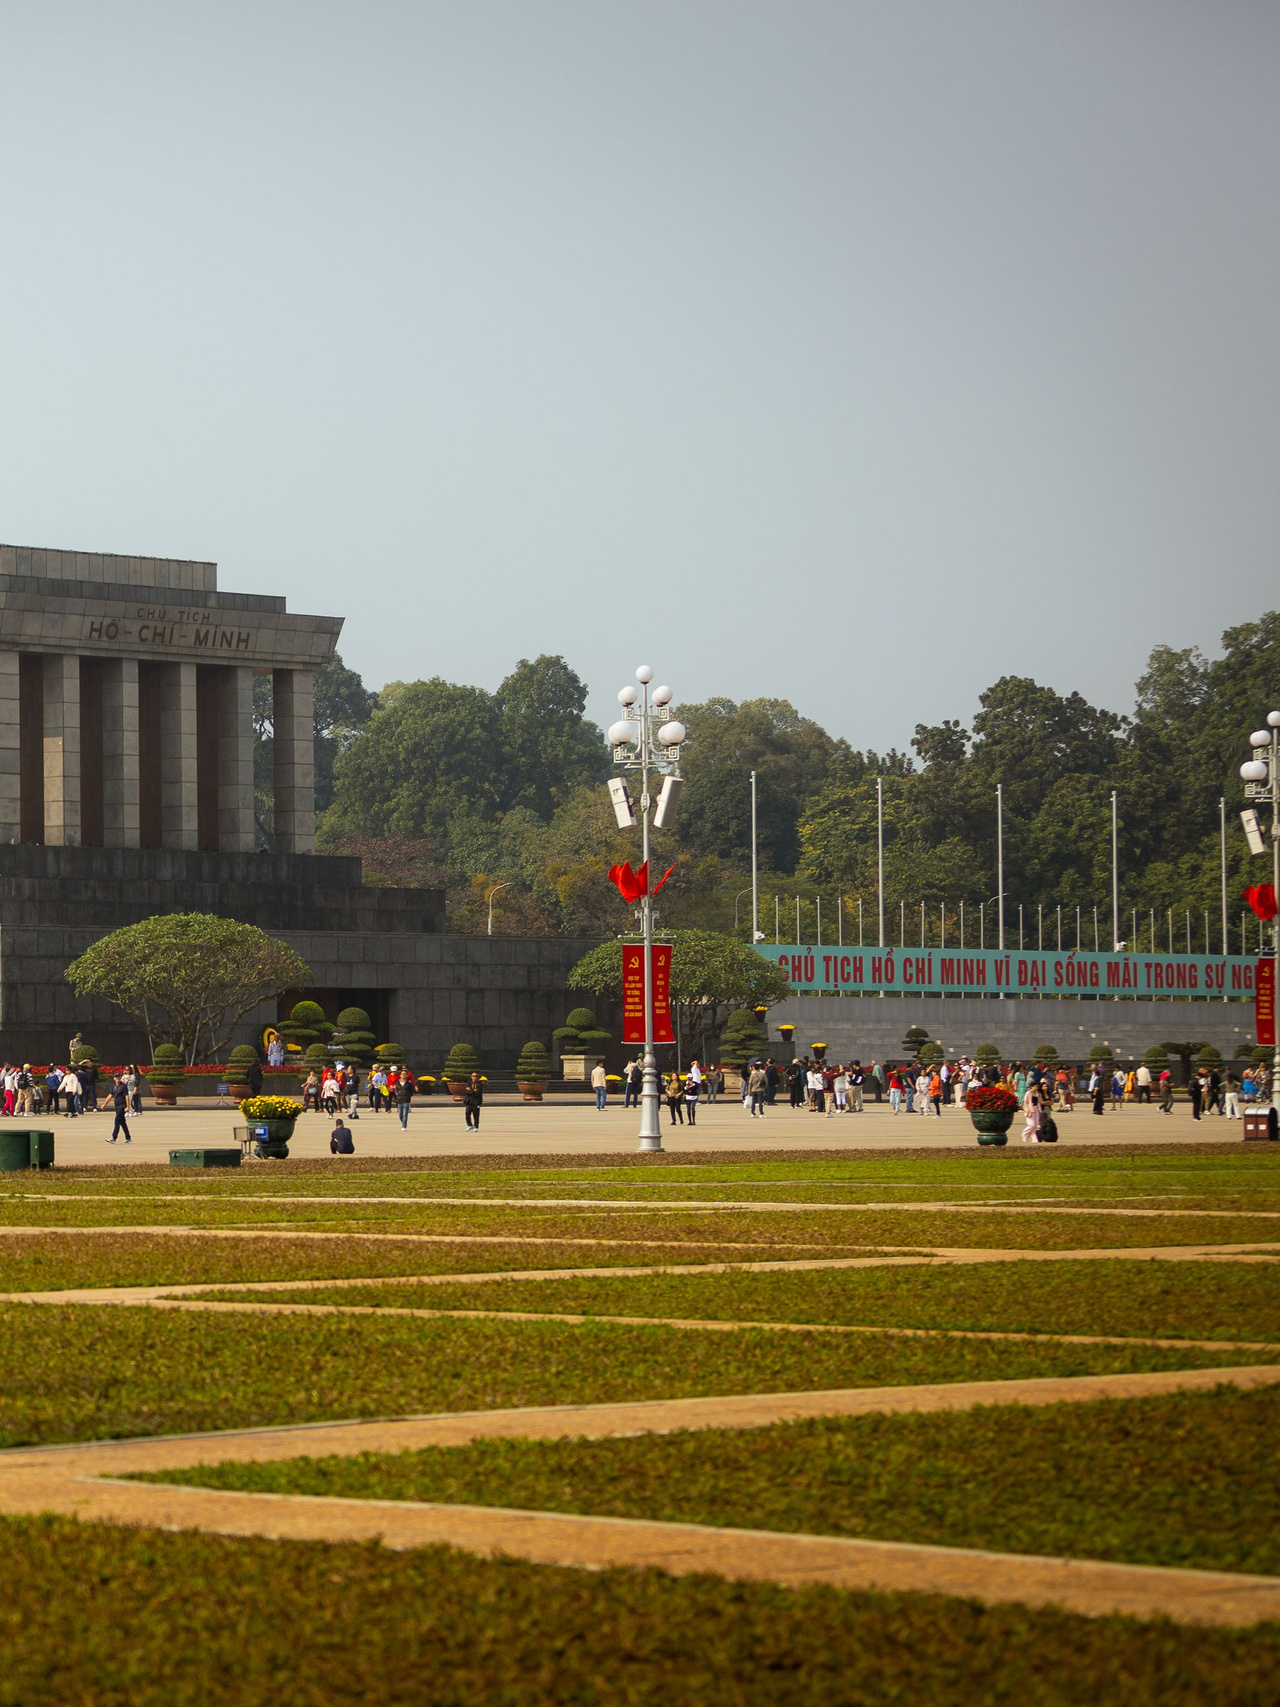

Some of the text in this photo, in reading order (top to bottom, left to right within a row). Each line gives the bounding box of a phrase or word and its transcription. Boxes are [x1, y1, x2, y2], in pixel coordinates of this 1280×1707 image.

[137, 604, 167, 620] CHỦ
[89, 618, 122, 641] HỒ
[138, 621, 177, 645] CHÍ
[193, 625, 251, 650] MINH
[778, 946, 815, 983] CHỦ
[823, 955, 864, 988] TỊCH
[872, 948, 895, 984] HỒ
[903, 952, 933, 985] CHÍ
[941, 958, 987, 986] MINH
[994, 955, 1011, 986] VĨ
[1017, 959, 1047, 991] ĐẠI
[1054, 952, 1100, 988] SỐNG
[1106, 957, 1138, 989] MÃI
[1145, 962, 1199, 989] TRONG
[1205, 961, 1227, 994] SỰ
